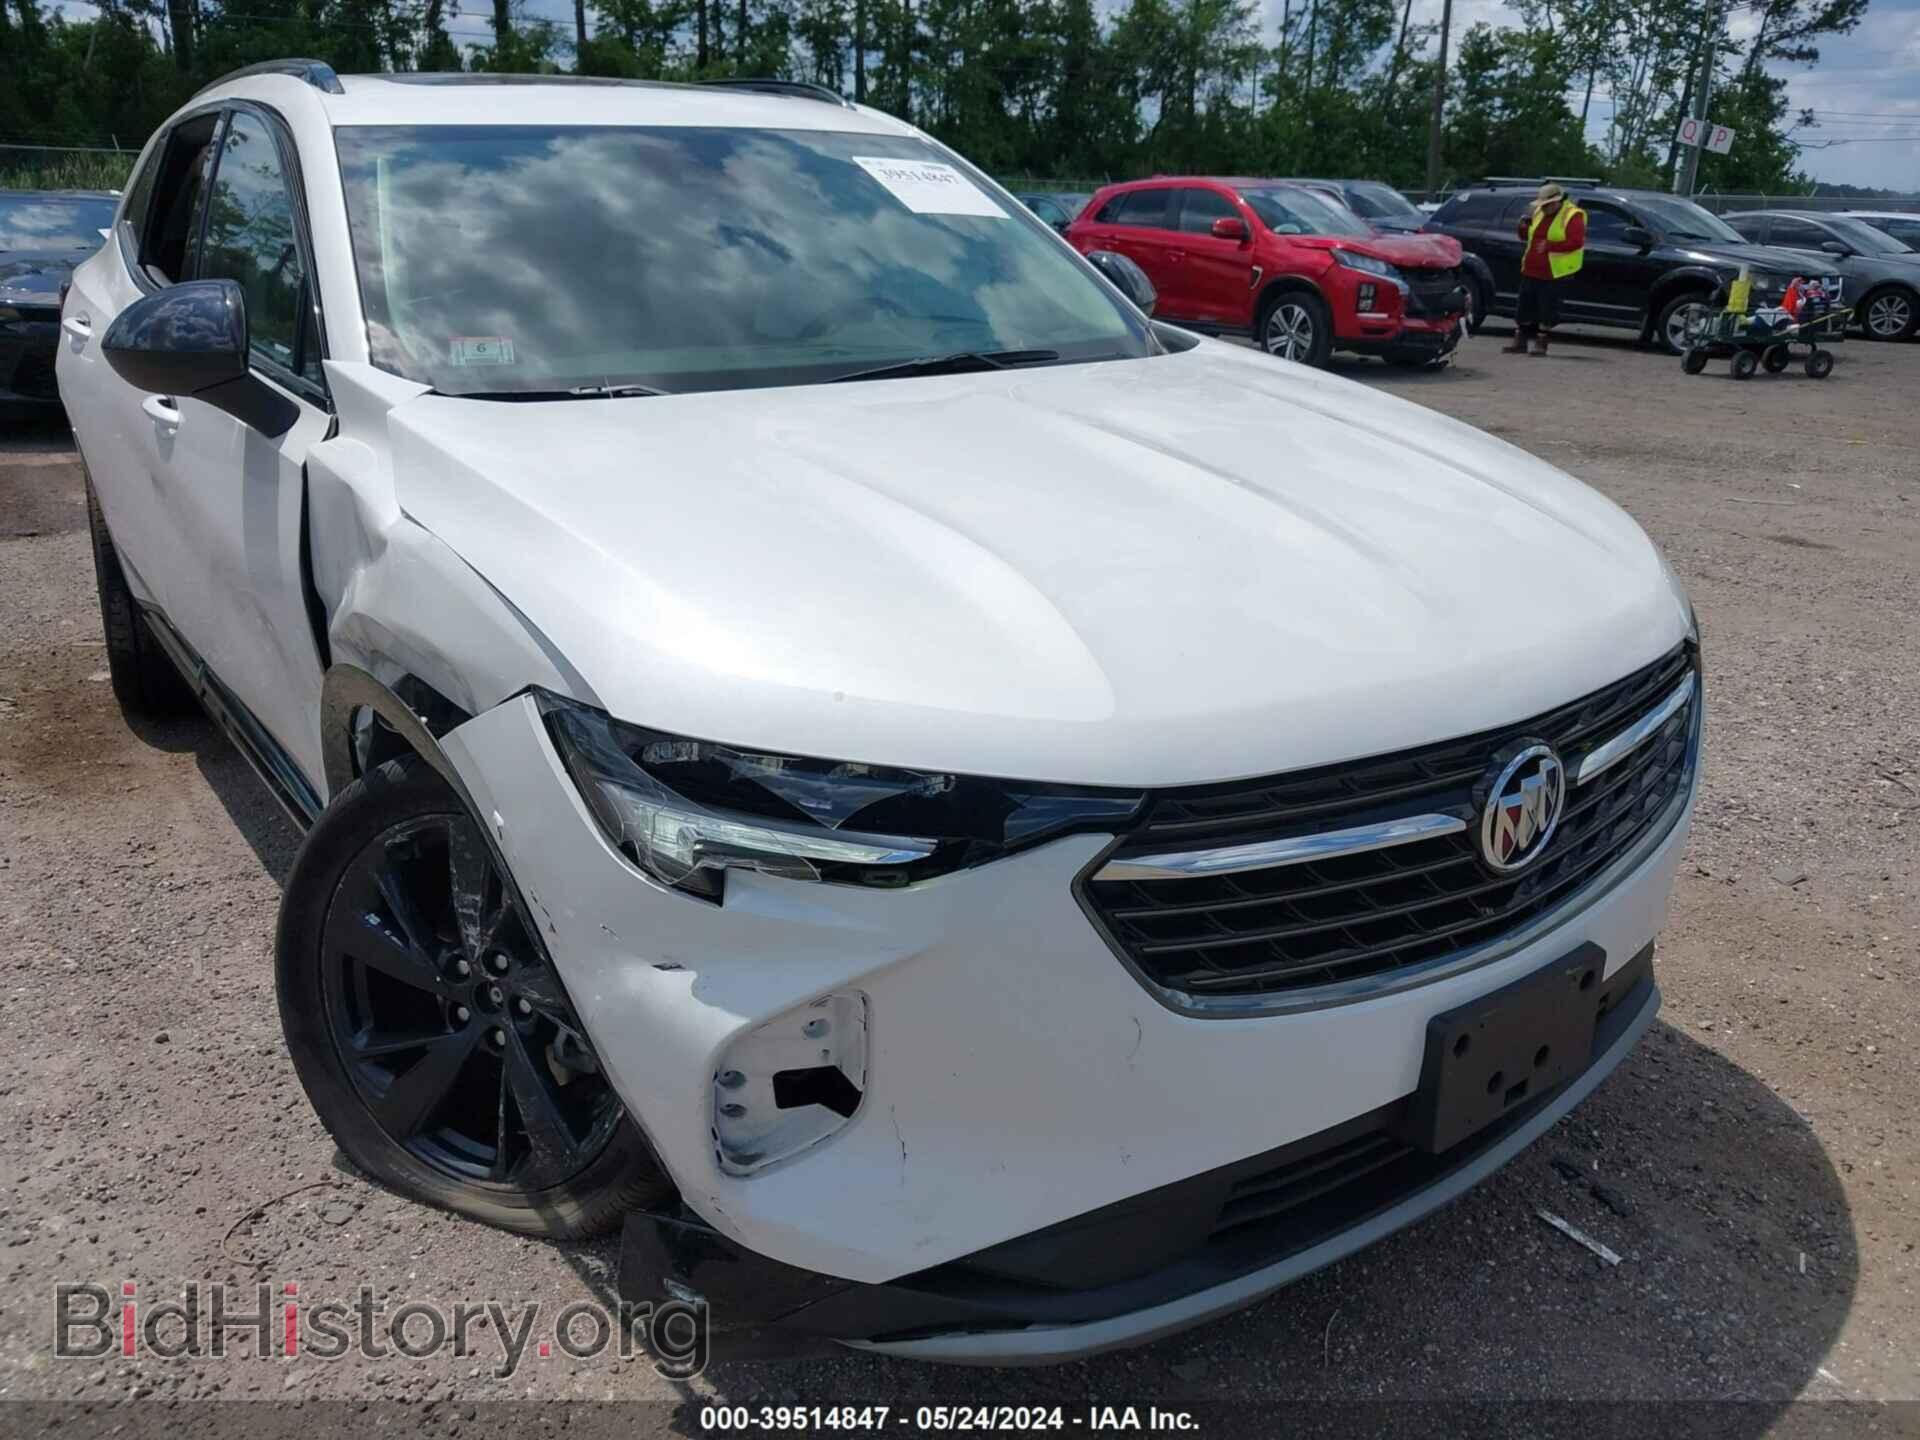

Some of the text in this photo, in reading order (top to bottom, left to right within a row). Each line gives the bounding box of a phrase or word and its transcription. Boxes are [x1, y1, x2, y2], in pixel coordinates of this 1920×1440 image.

[1682, 120, 1697, 143] Q
[1713, 128, 1728, 147] P
[476, 343, 487, 353] 6
